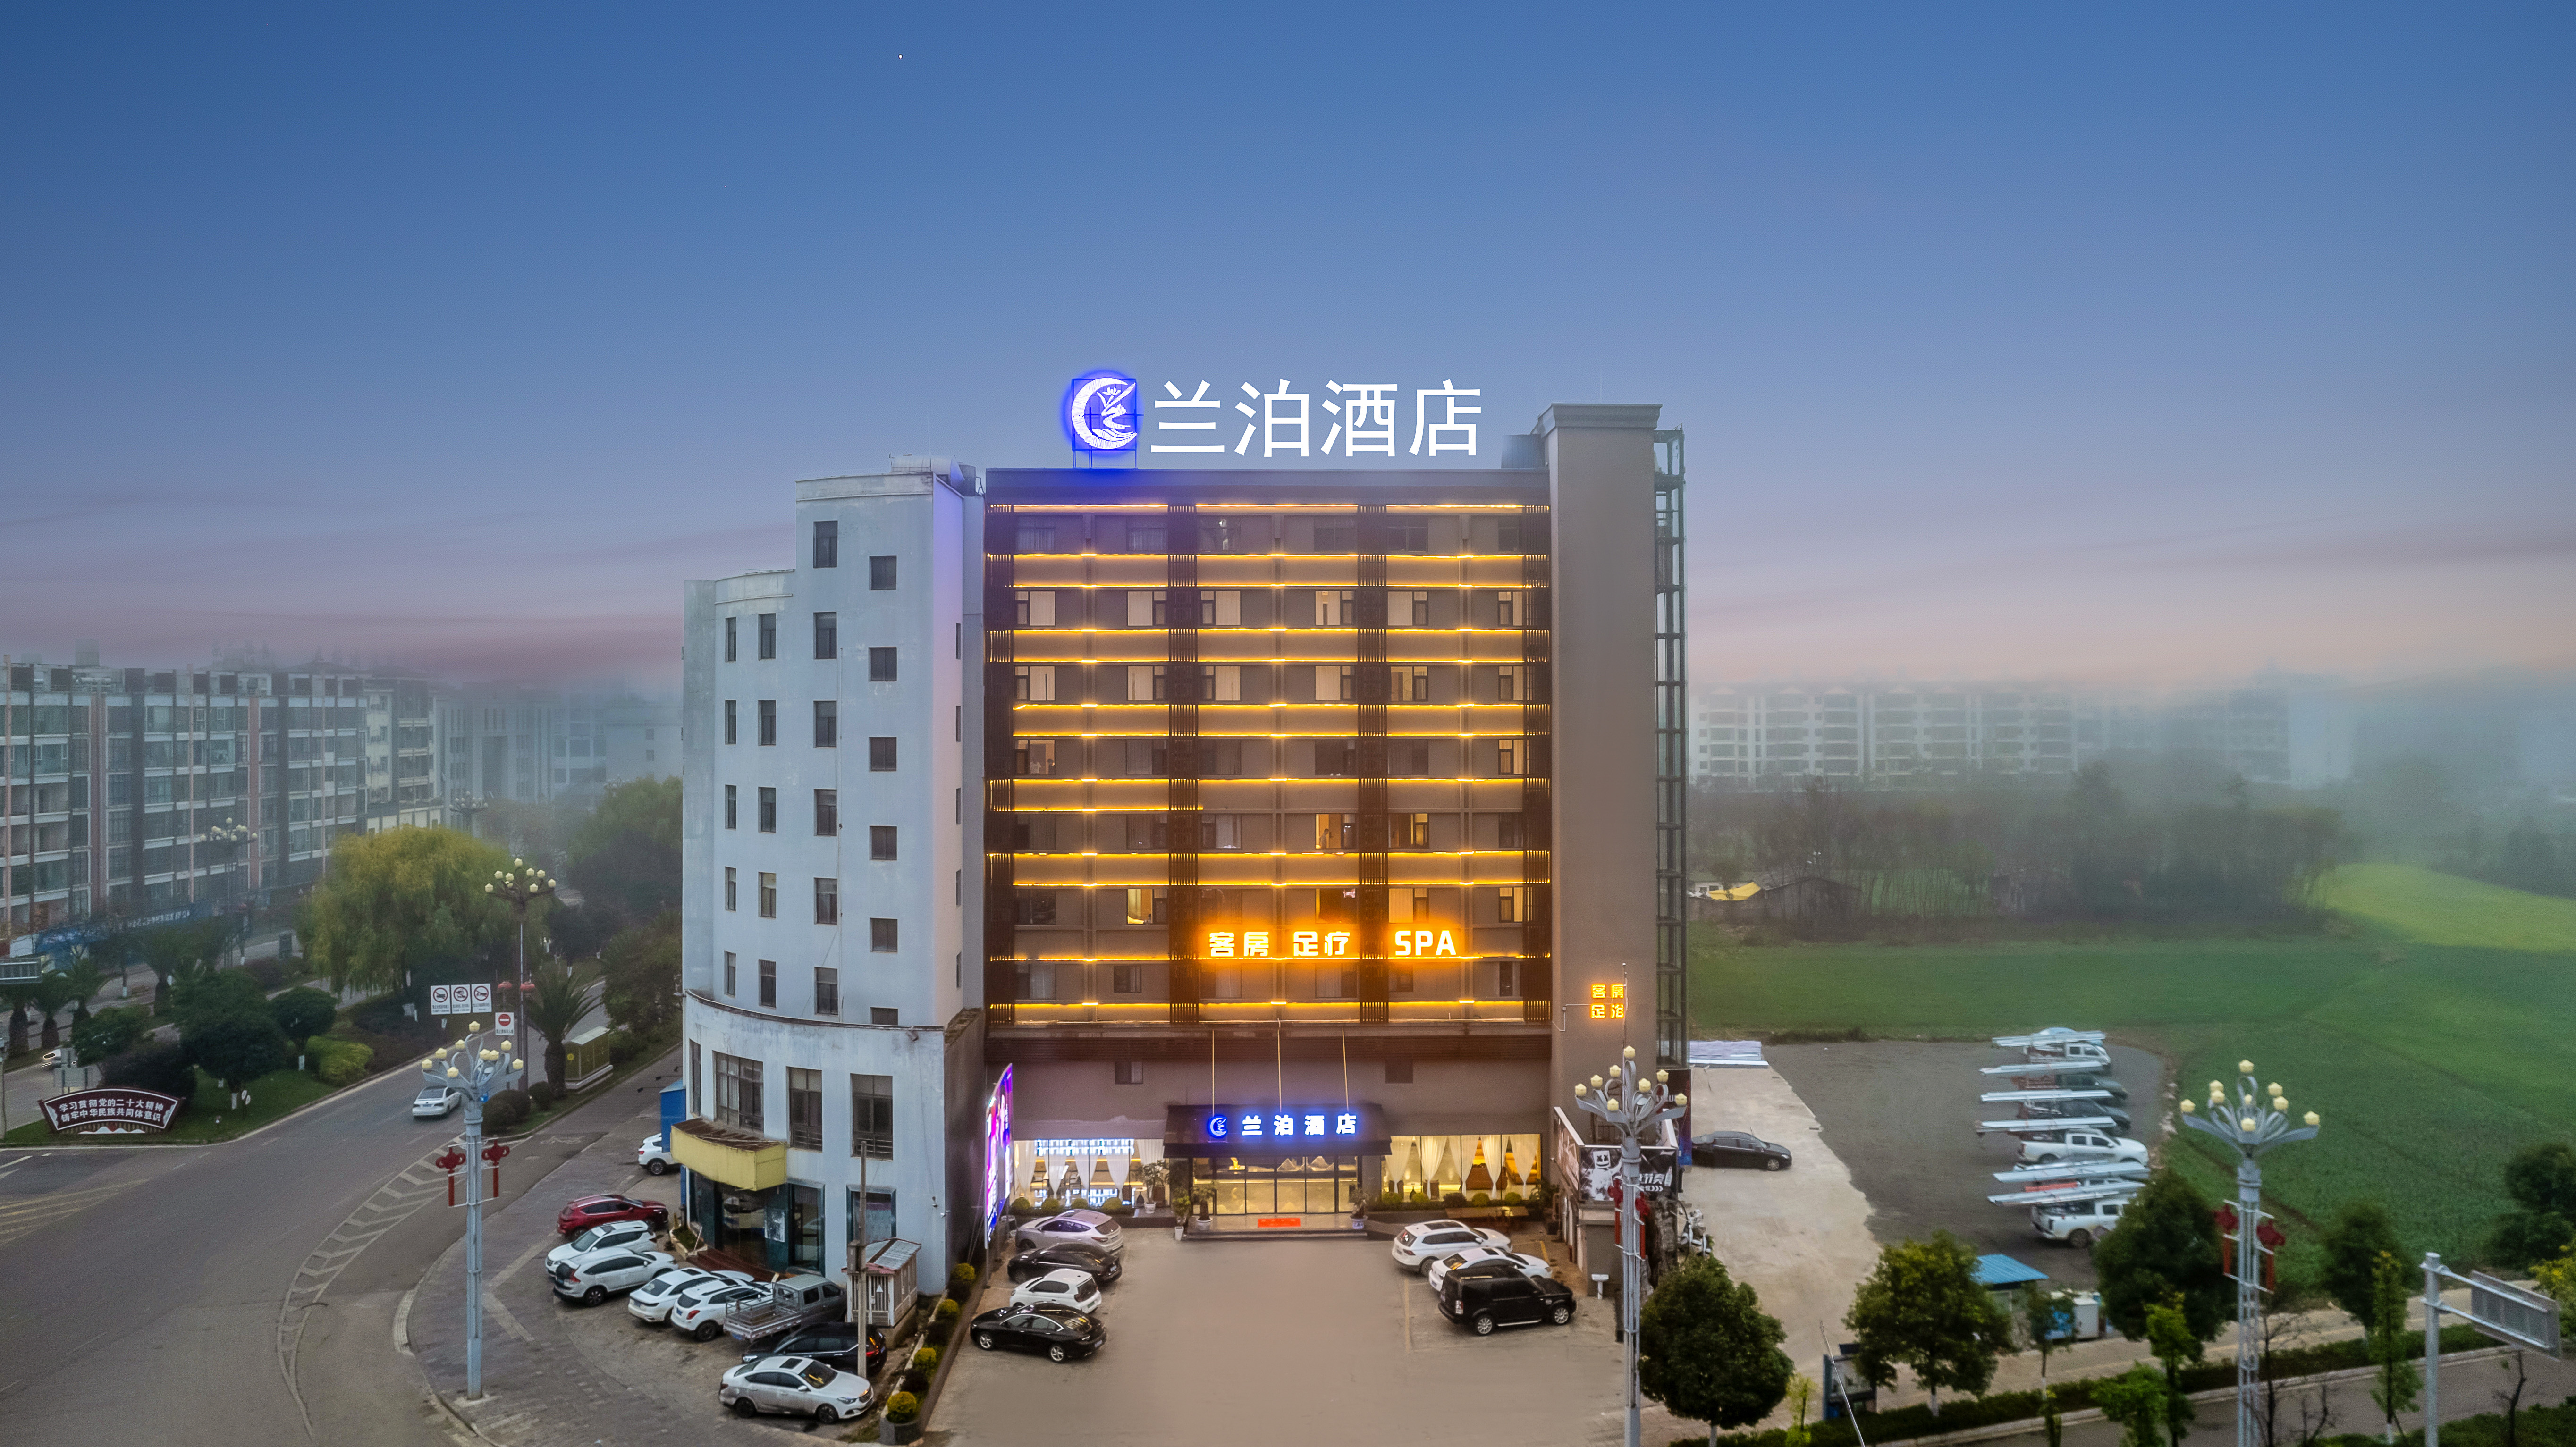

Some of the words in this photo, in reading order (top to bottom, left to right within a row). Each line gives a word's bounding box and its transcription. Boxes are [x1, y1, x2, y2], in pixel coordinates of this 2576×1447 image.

[1150, 379, 1481, 457] 兰泊酒店
[1209, 931, 1269, 957] 客房
[1293, 931, 1351, 957] 足疗
[1395, 930, 1457, 956] SPA
[1591, 984, 1624, 998] 客房
[1590, 1003, 1624, 1018] 足浴
[59, 1099, 164, 1112] 学习贯彻党的二十大精神
[61, 1108, 161, 1122] 铸牢中华民族共同体意识
[1242, 1113, 1357, 1136] 兰泊酒店
